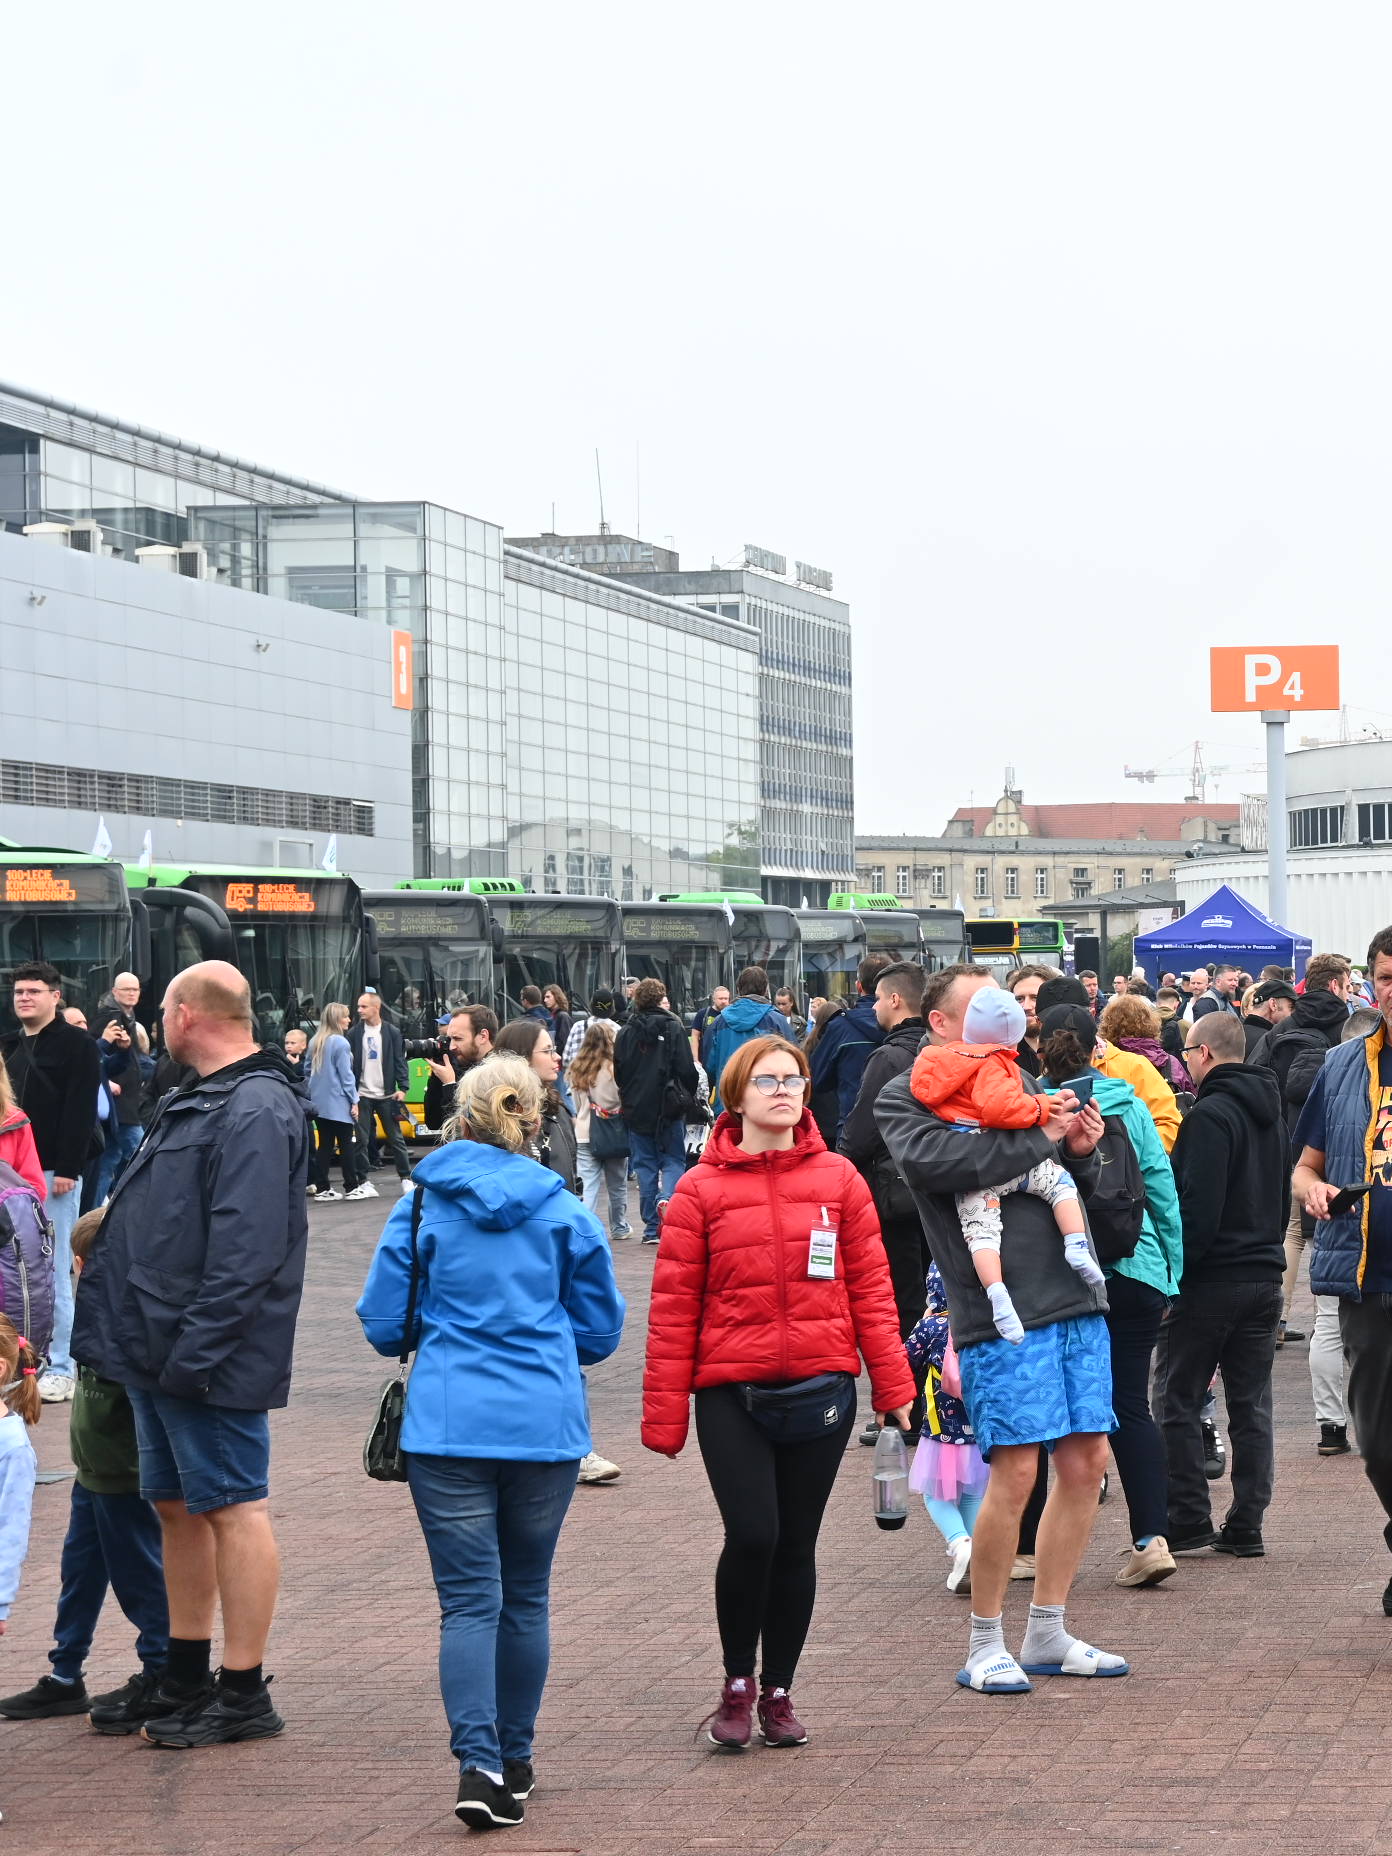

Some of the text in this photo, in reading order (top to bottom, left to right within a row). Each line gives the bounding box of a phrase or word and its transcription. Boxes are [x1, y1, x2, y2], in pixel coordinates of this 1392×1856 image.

[1244, 654, 1304, 702] P4
[6, 880, 70, 890] KOMUNIKACJI
[6, 889, 77, 901] AUTOBUSOWEJ
[257, 893, 310, 901] KOMUNIKACJI
[257, 901, 316, 912] AUTOBUSOWEJ
